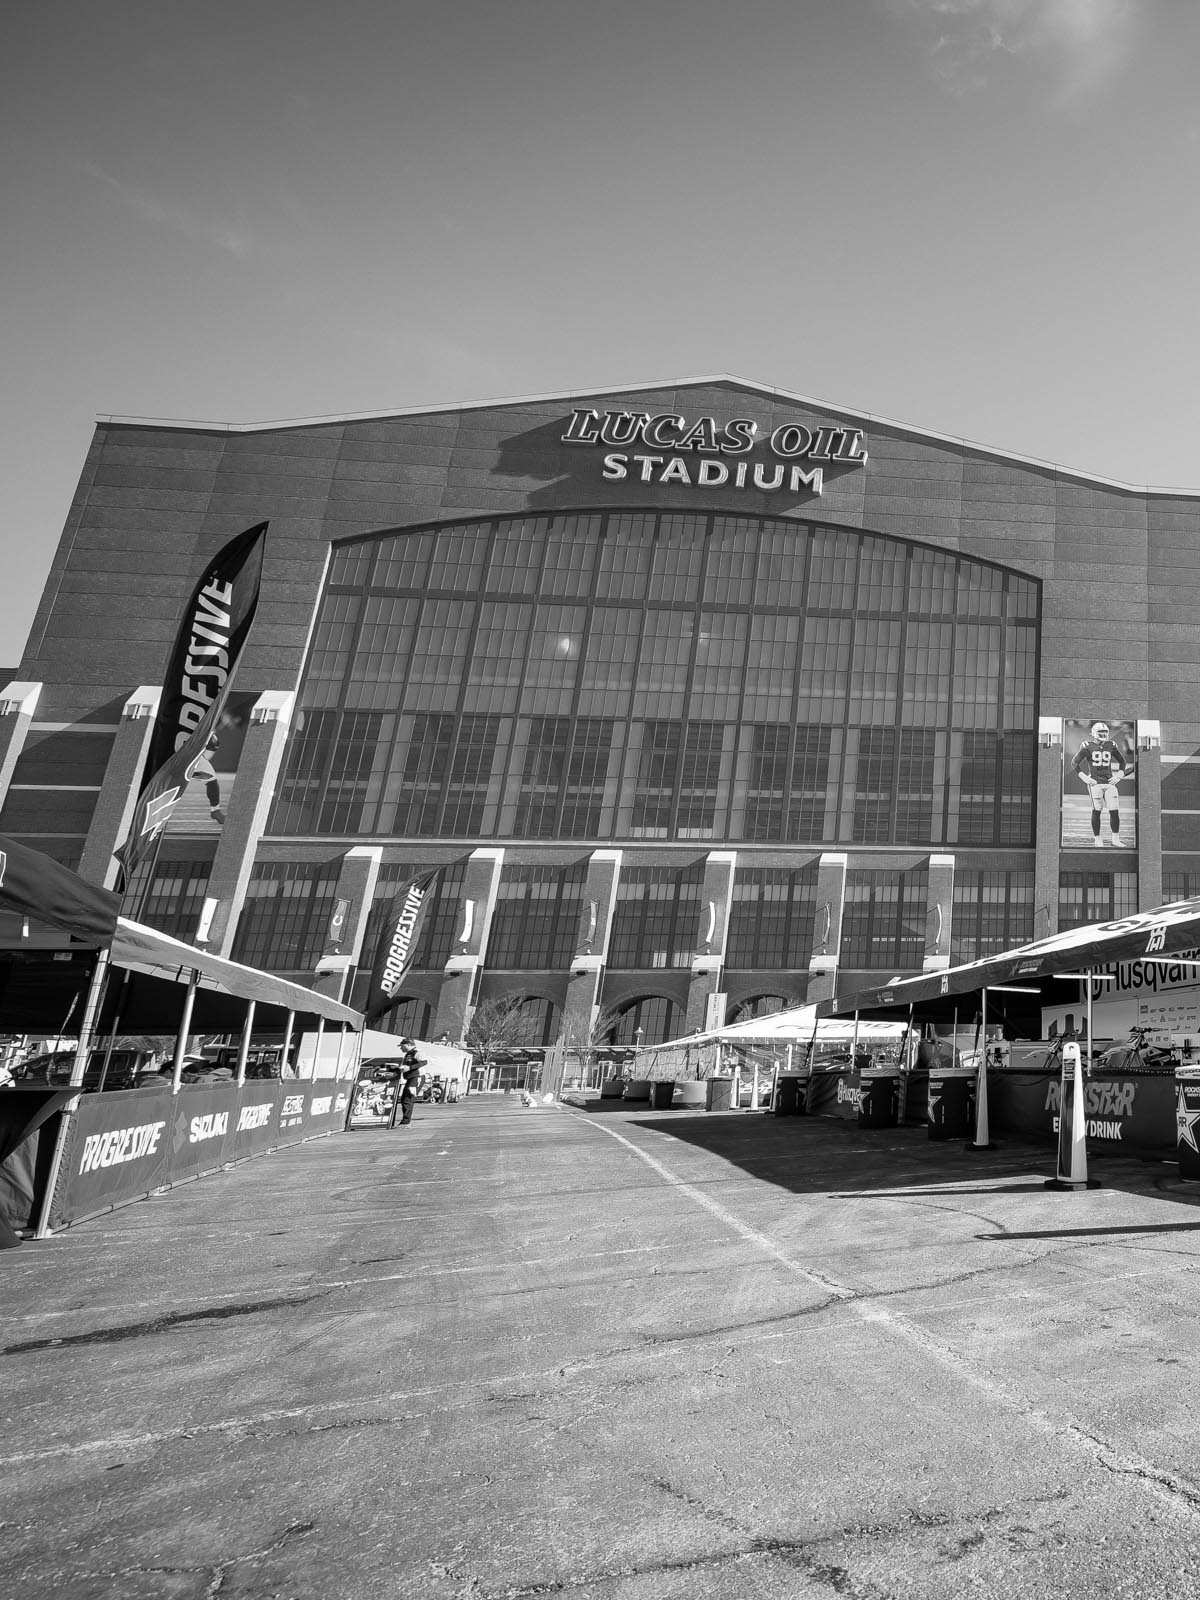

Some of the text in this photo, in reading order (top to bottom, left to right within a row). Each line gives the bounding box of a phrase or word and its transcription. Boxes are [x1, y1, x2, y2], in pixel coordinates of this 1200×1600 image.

[561, 408, 868, 466] LUCAS OIL
[602, 453, 824, 496] STADIUM
[1091, 751, 1112, 767] 99
[381, 884, 425, 998] PROGRESSIVE
[1090, 1120, 1122, 1140] DRINK
